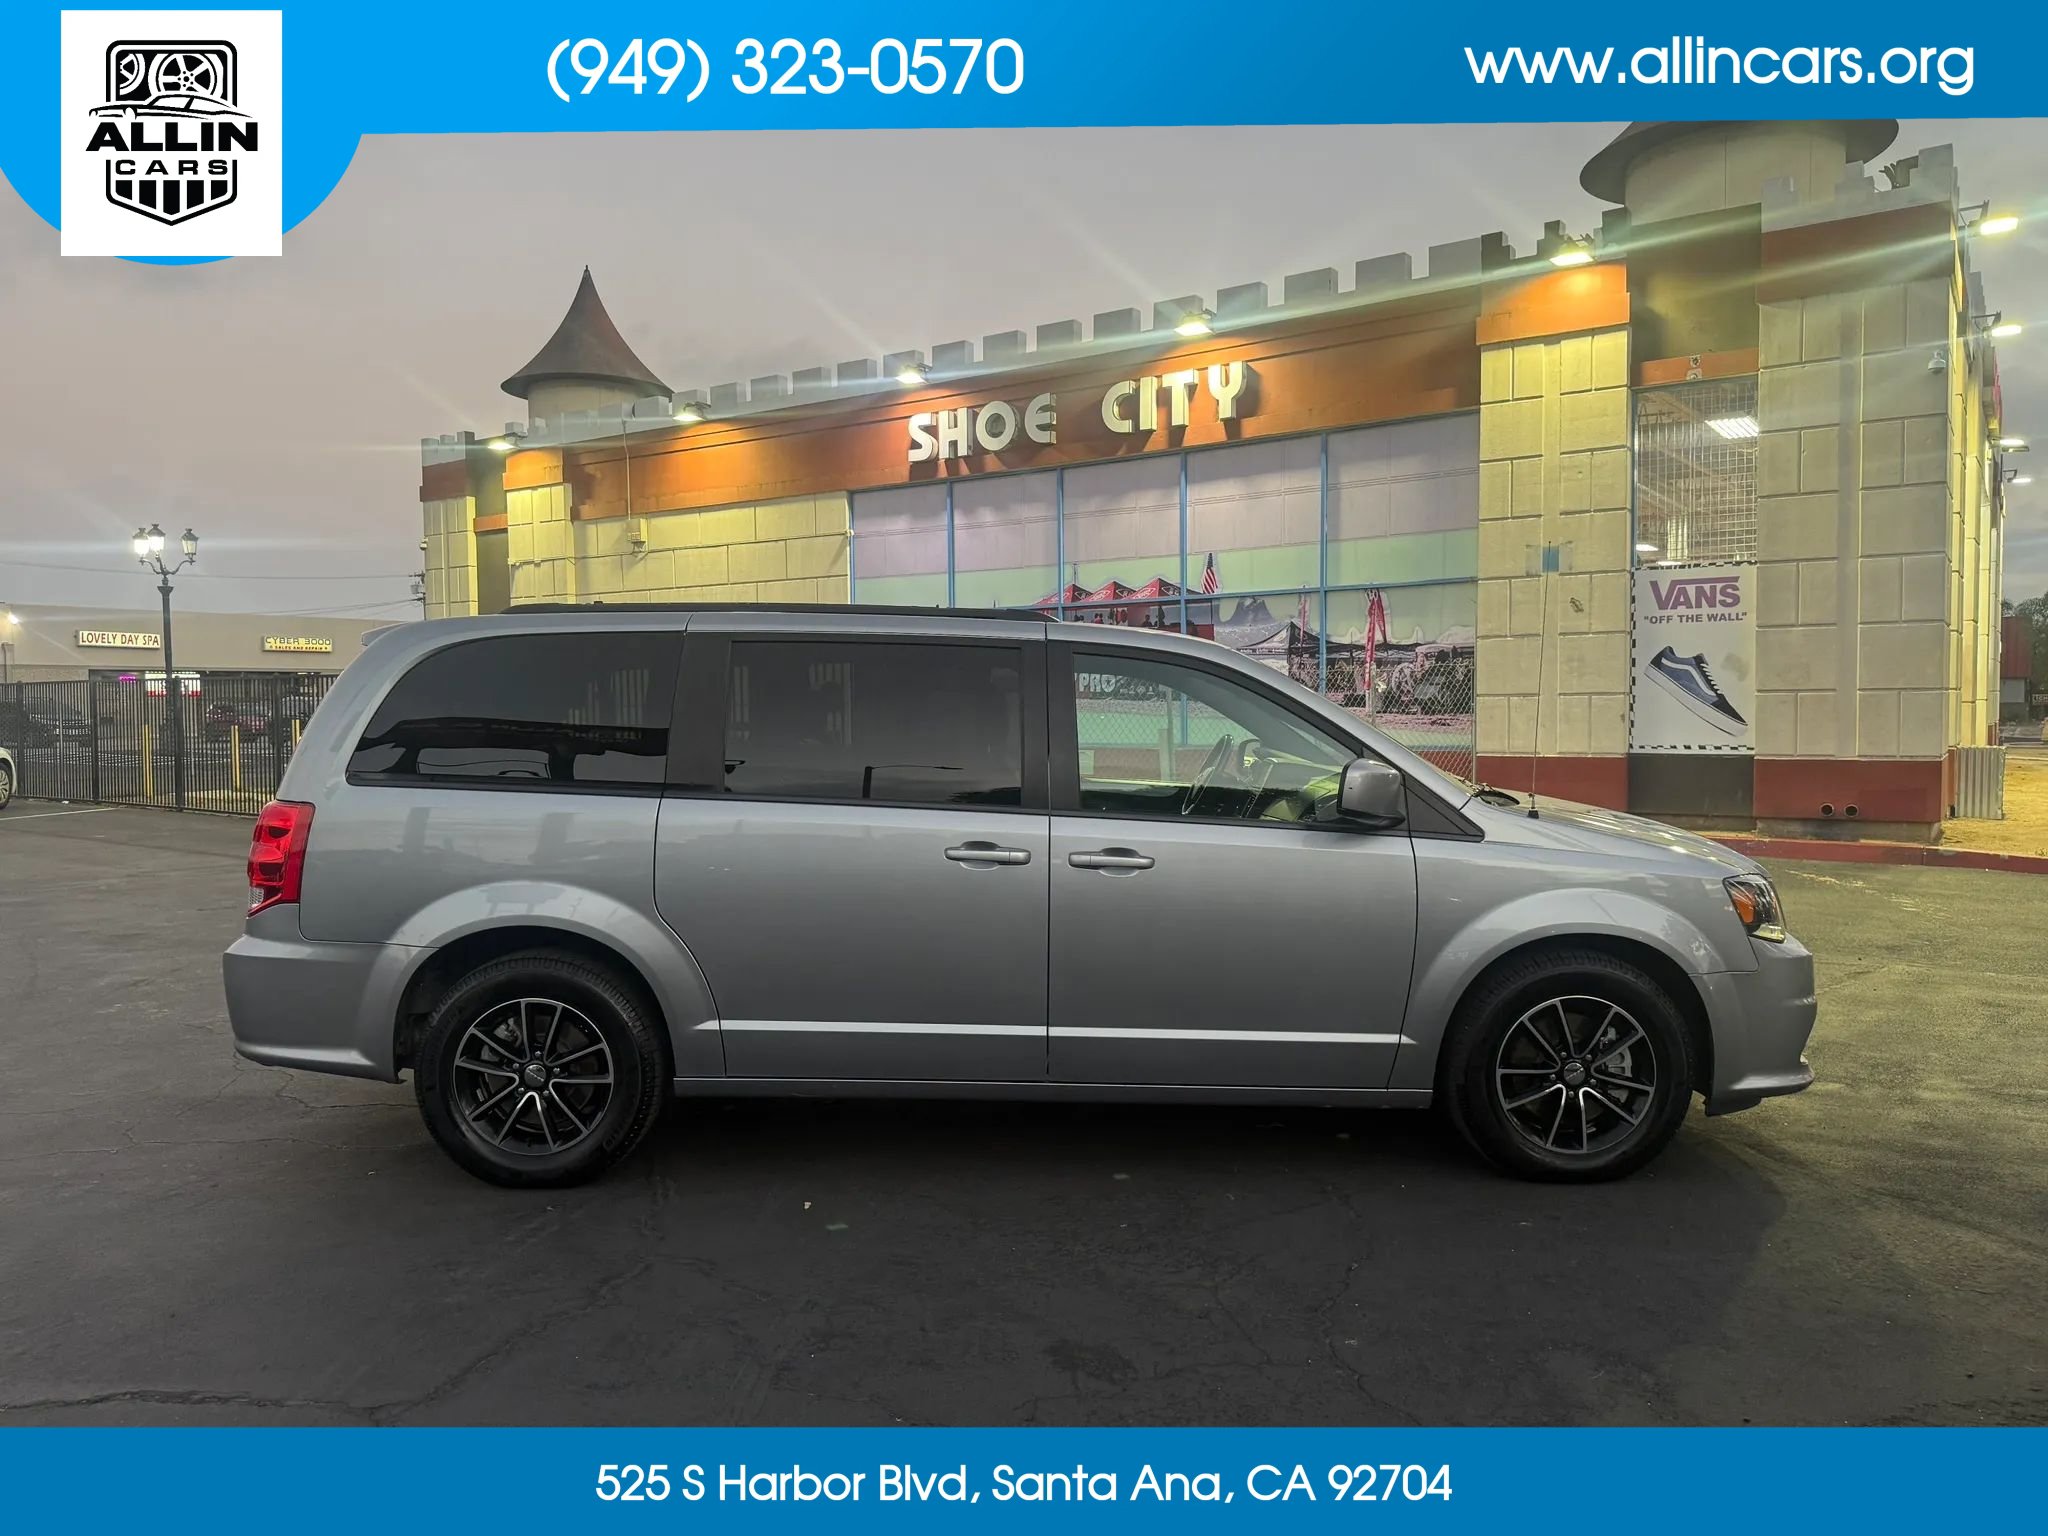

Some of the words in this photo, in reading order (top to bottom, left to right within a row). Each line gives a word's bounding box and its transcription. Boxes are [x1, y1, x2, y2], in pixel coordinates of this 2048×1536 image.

[908, 392, 1057, 463] SHOE
[1102, 360, 1249, 433] CITY
[1649, 576, 1740, 610] VANS
[1644, 615, 1673, 625] "OFF
[1677, 614, 1703, 623] THE
[1707, 612, 1747, 622] WALL"
[81, 632, 117, 644] LOVELY
[121, 634, 139, 645] DAY
[142, 635, 159, 646] SPA
[265, 636, 300, 645] CYBER
[304, 638, 331, 646] 3000
